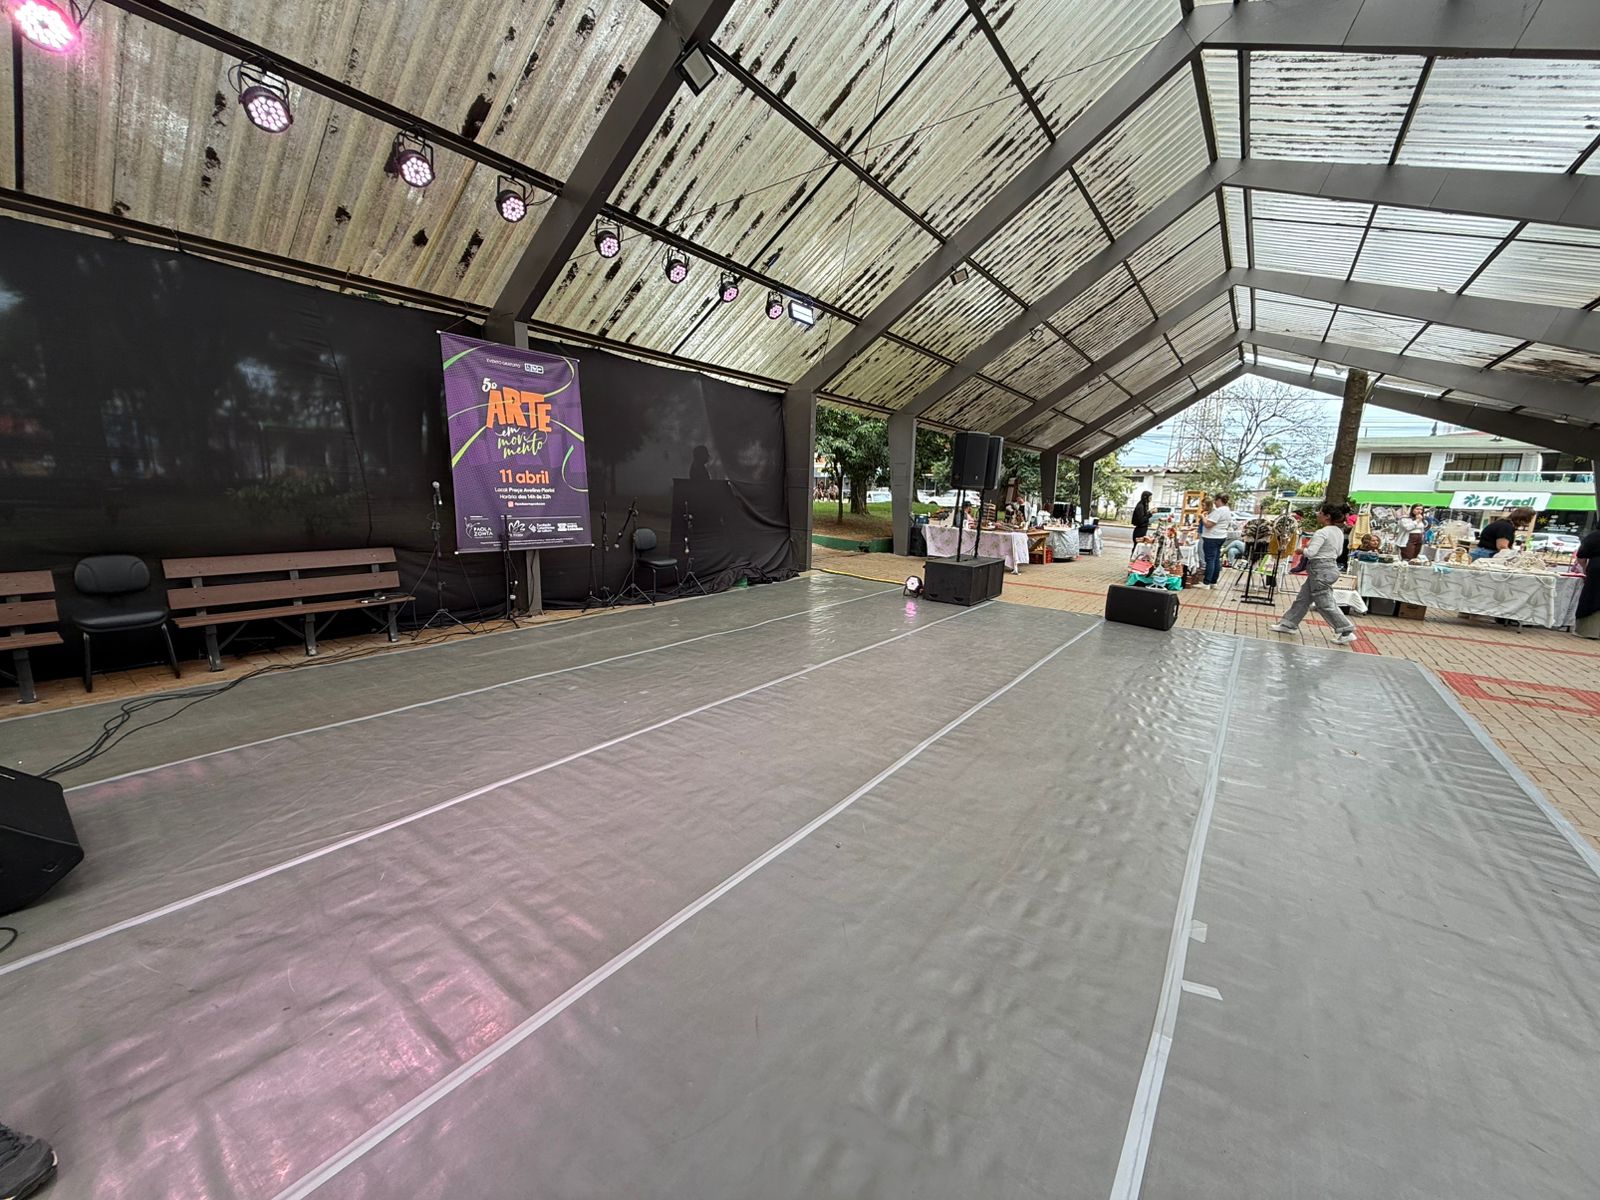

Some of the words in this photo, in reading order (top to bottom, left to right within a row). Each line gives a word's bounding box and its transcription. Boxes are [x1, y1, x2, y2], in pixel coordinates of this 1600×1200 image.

[486, 386, 552, 432] ARTE
[495, 426, 521, 437] em
[499, 468, 513, 483] 11
[515, 469, 550, 484] abril
[1482, 496, 1537, 507] Sicredi
